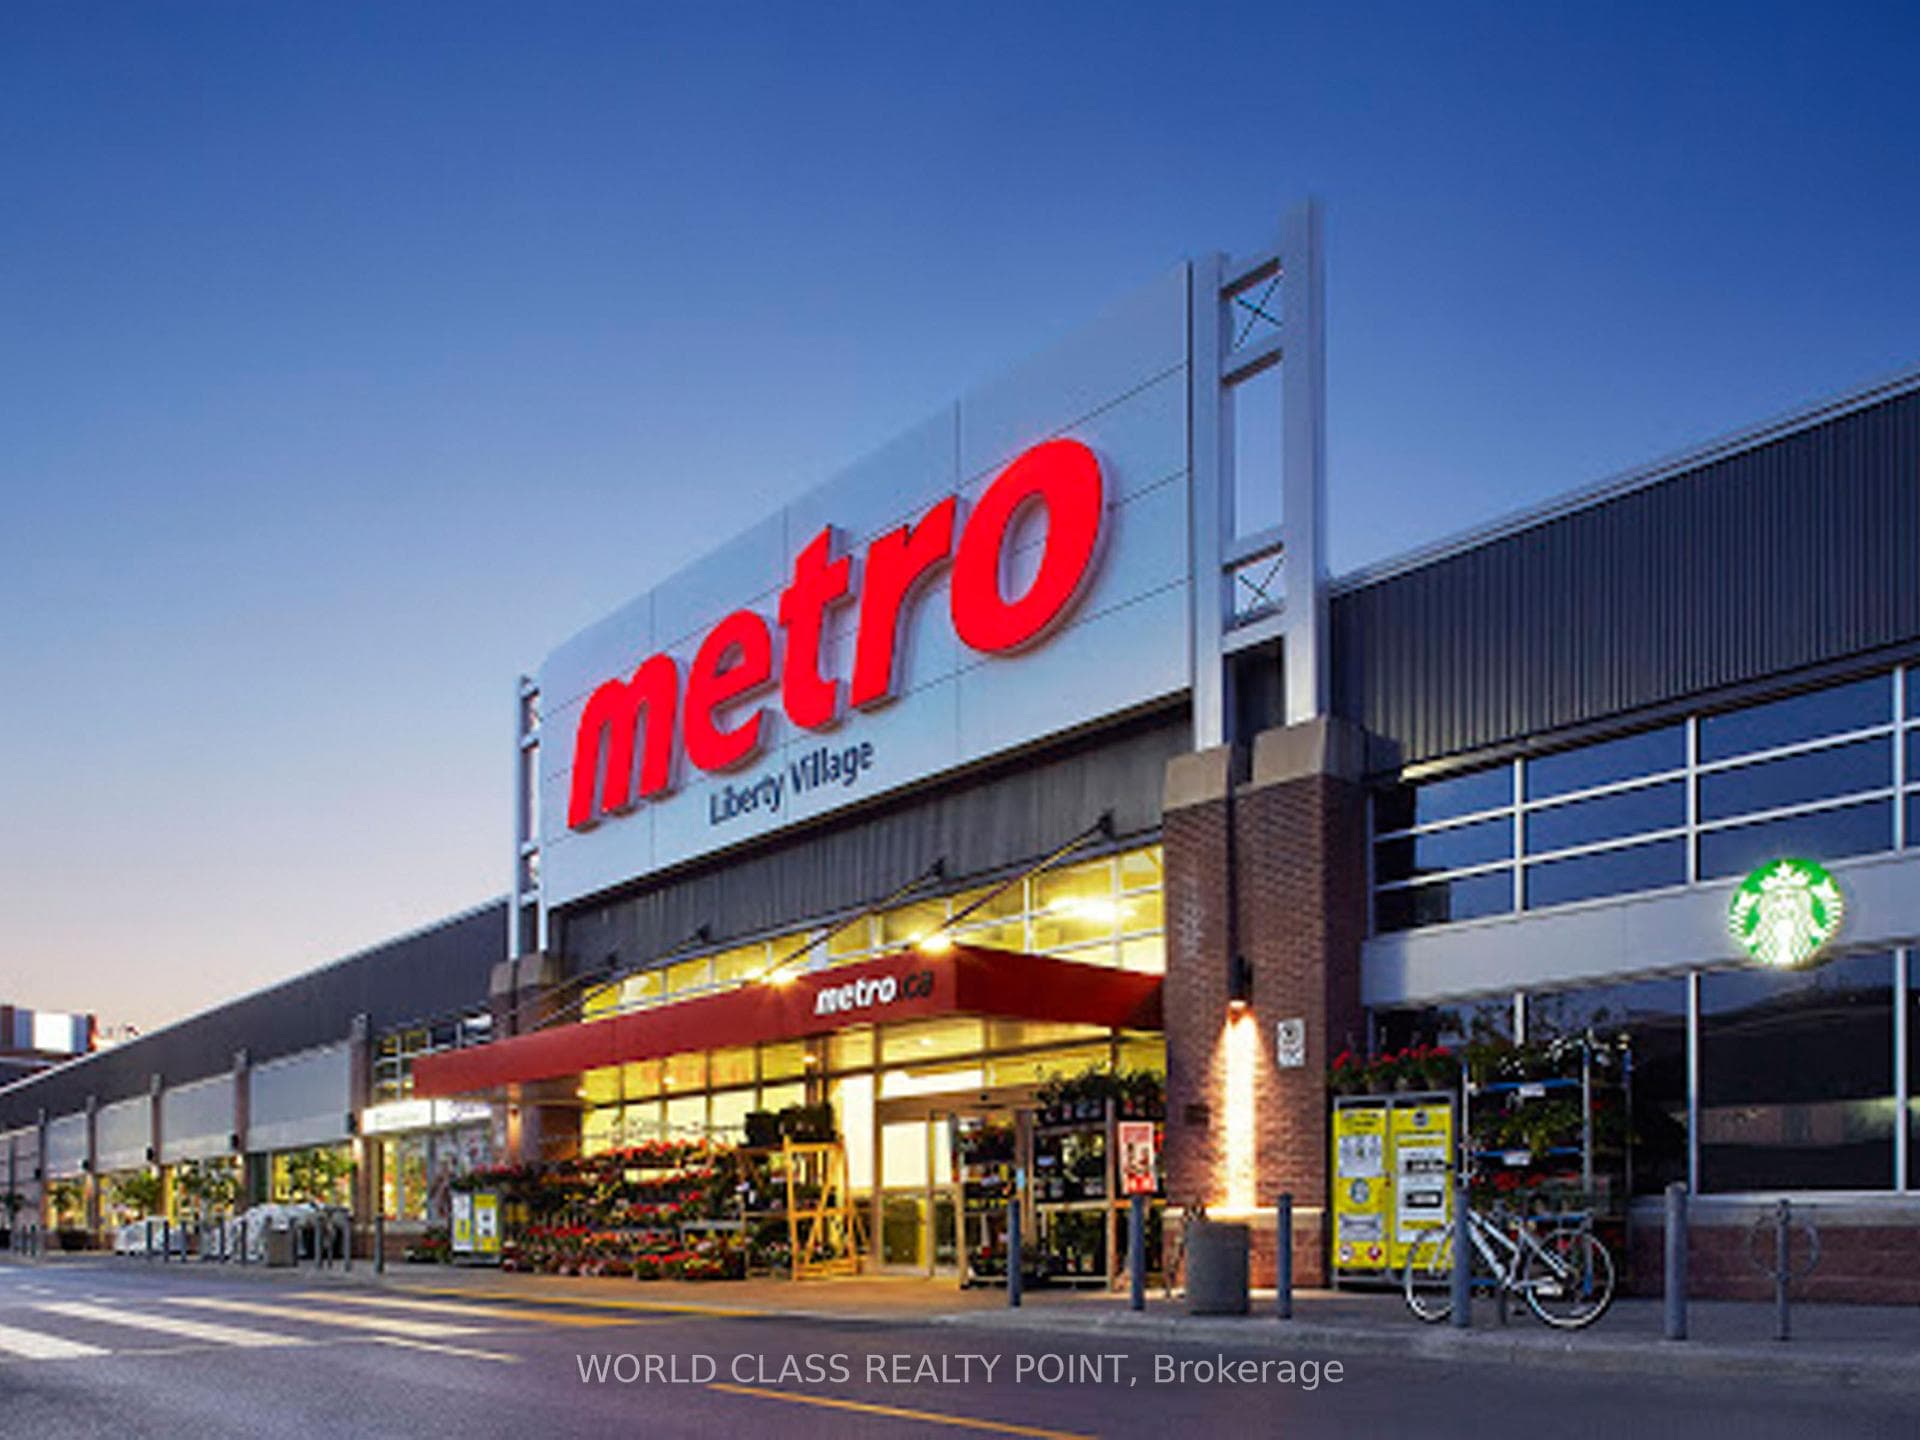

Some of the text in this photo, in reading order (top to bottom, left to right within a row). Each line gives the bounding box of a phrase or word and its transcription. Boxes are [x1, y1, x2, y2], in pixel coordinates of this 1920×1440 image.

[567, 438, 1104, 829] metro
[709, 742, 873, 825] Liberty Village
